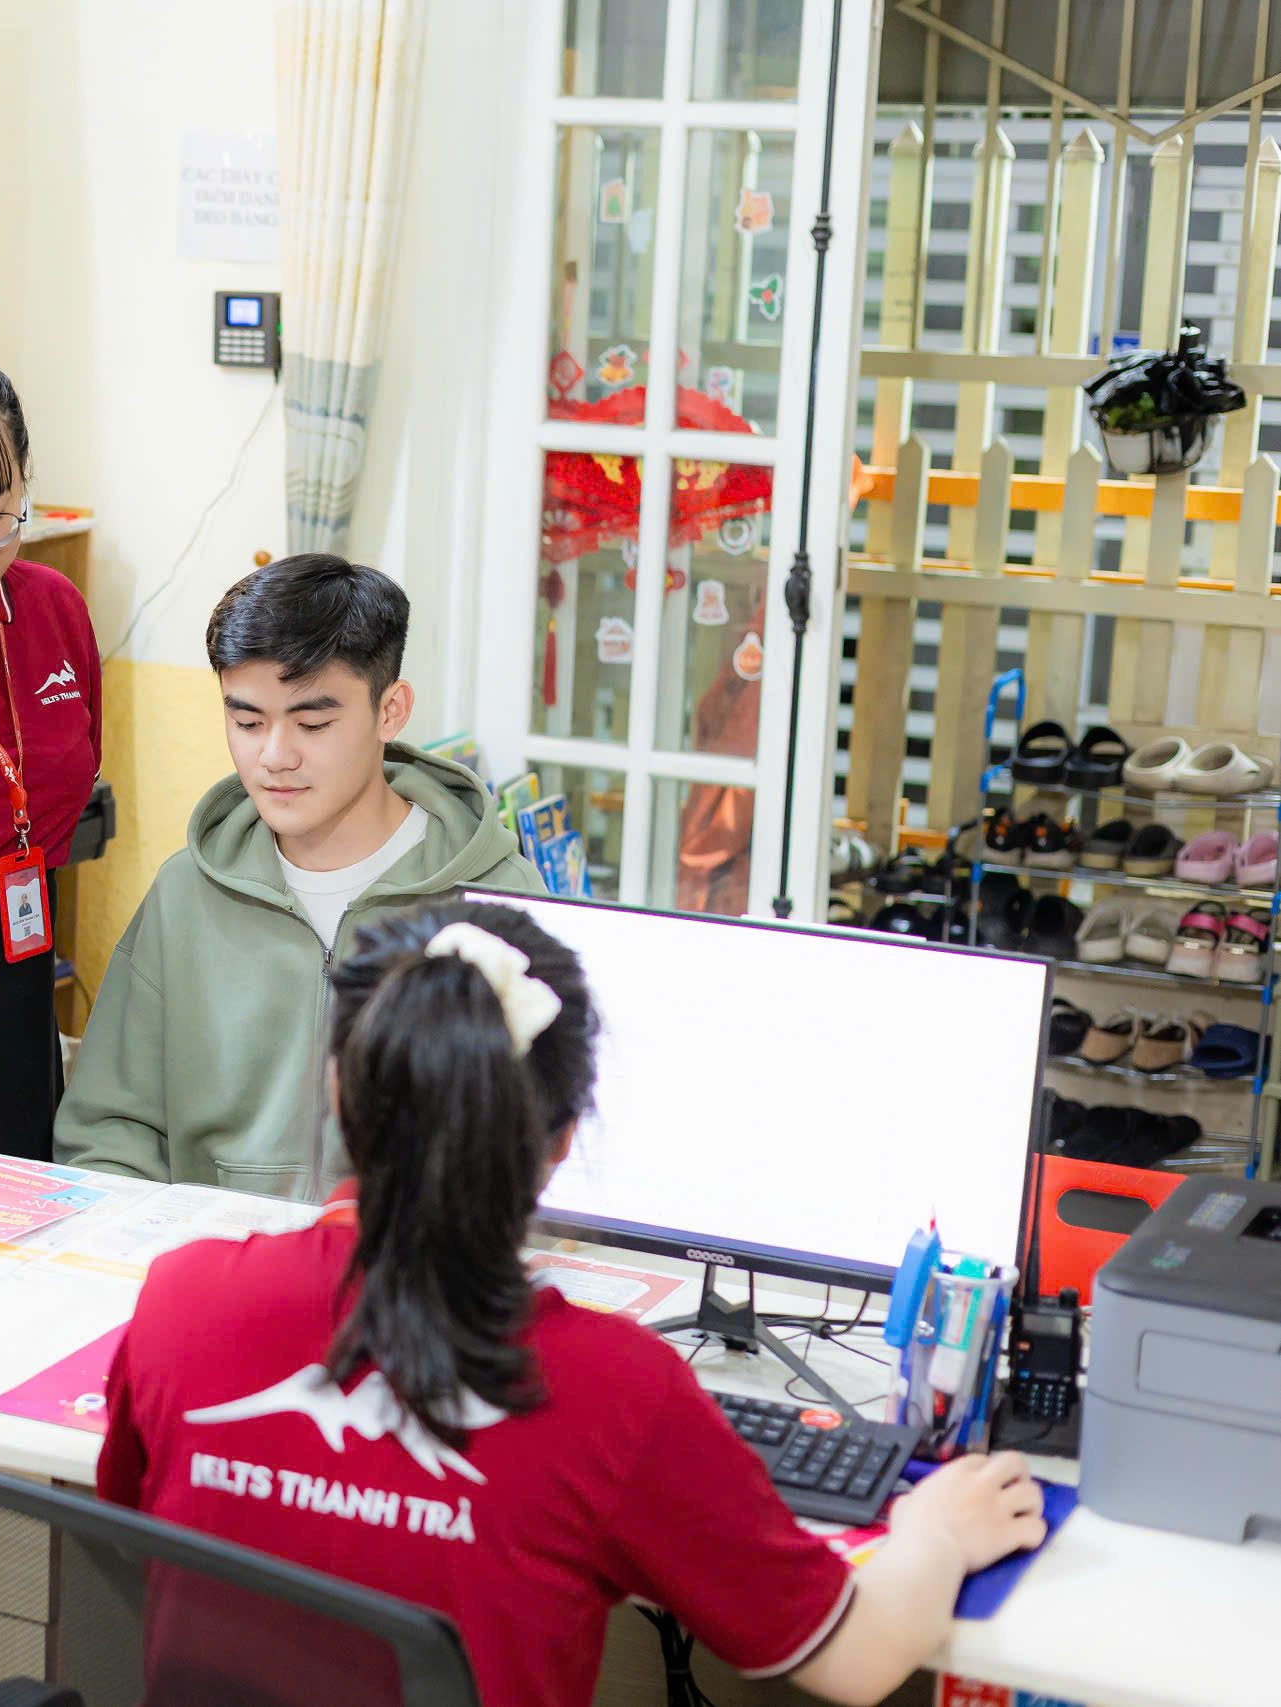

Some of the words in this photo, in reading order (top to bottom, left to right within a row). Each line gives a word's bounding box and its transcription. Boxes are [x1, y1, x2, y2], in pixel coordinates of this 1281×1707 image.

[40, 694, 60, 705] IELTS
[59, 691, 81, 700] THANH
[190, 1452, 273, 1499] IELTS
[278, 1469, 400, 1529] THANH
